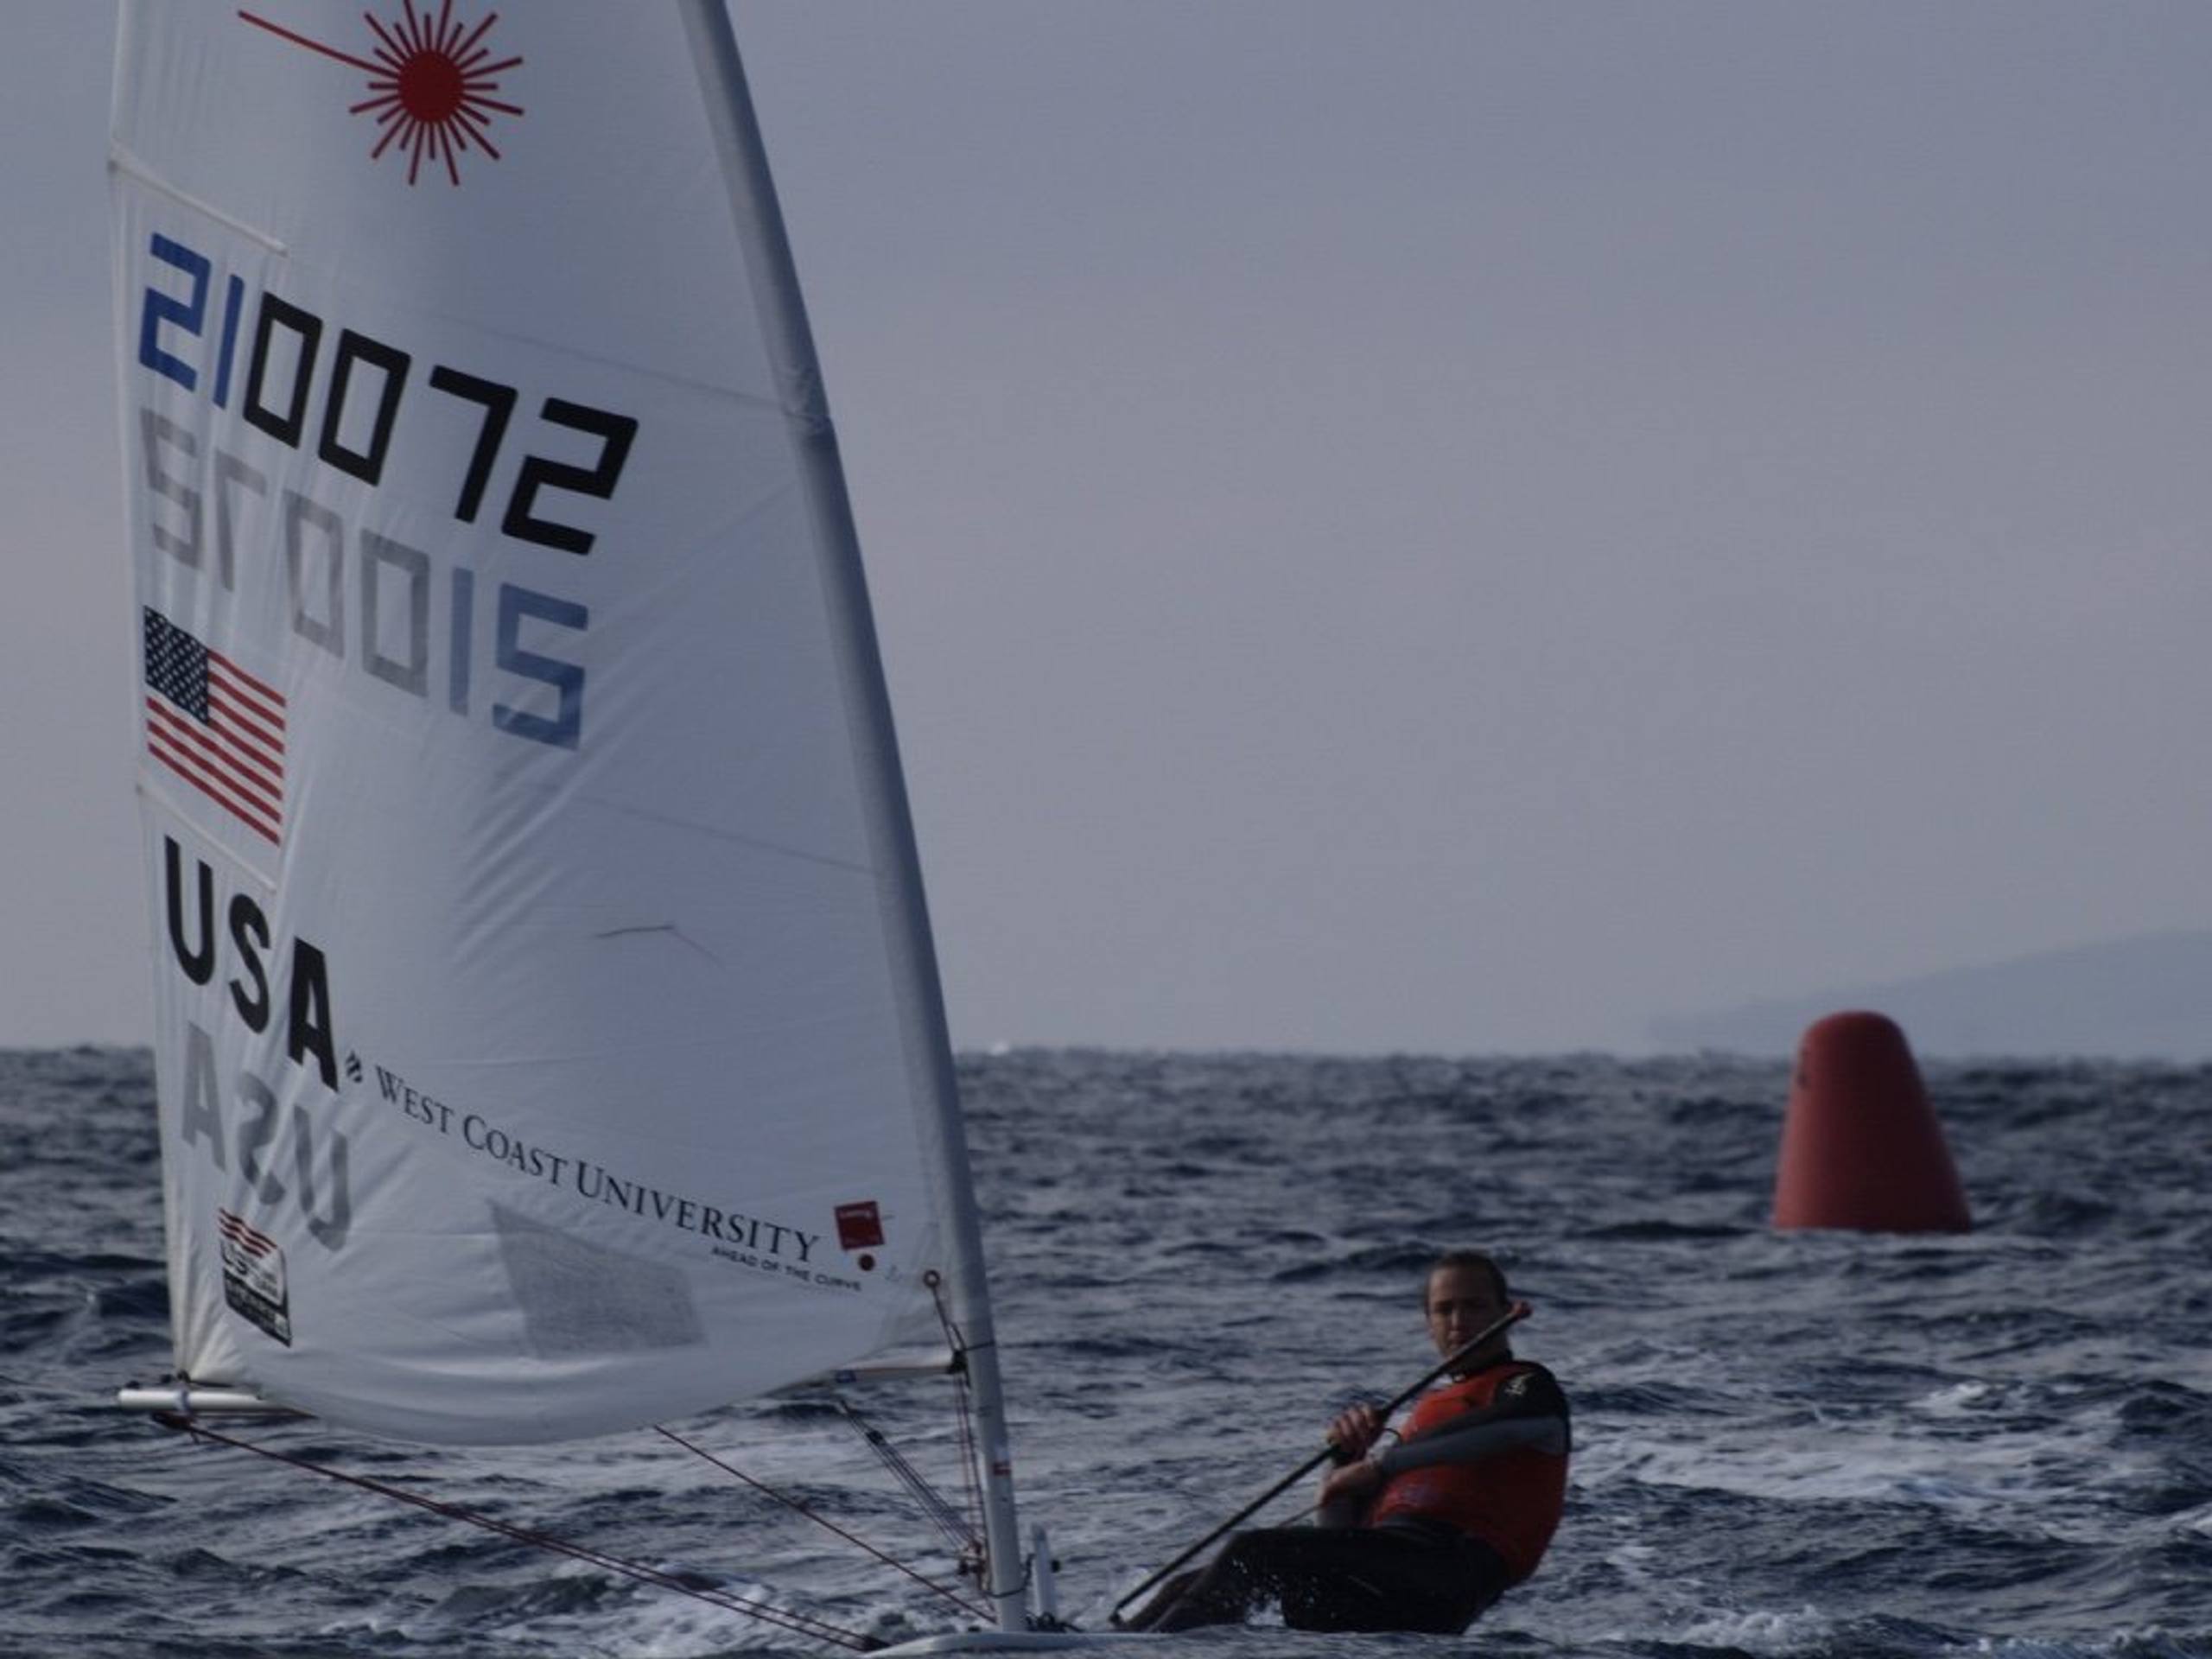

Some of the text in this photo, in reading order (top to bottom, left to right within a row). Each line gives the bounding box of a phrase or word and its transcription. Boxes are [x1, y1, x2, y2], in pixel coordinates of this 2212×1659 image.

[138, 232, 639, 556] 210072
[165, 835, 340, 1093] USA
[374, 1065, 822, 1264] WEST COAST UNIVERSITY
[711, 1246, 862, 1293] AHEAD OF THE CURVE
